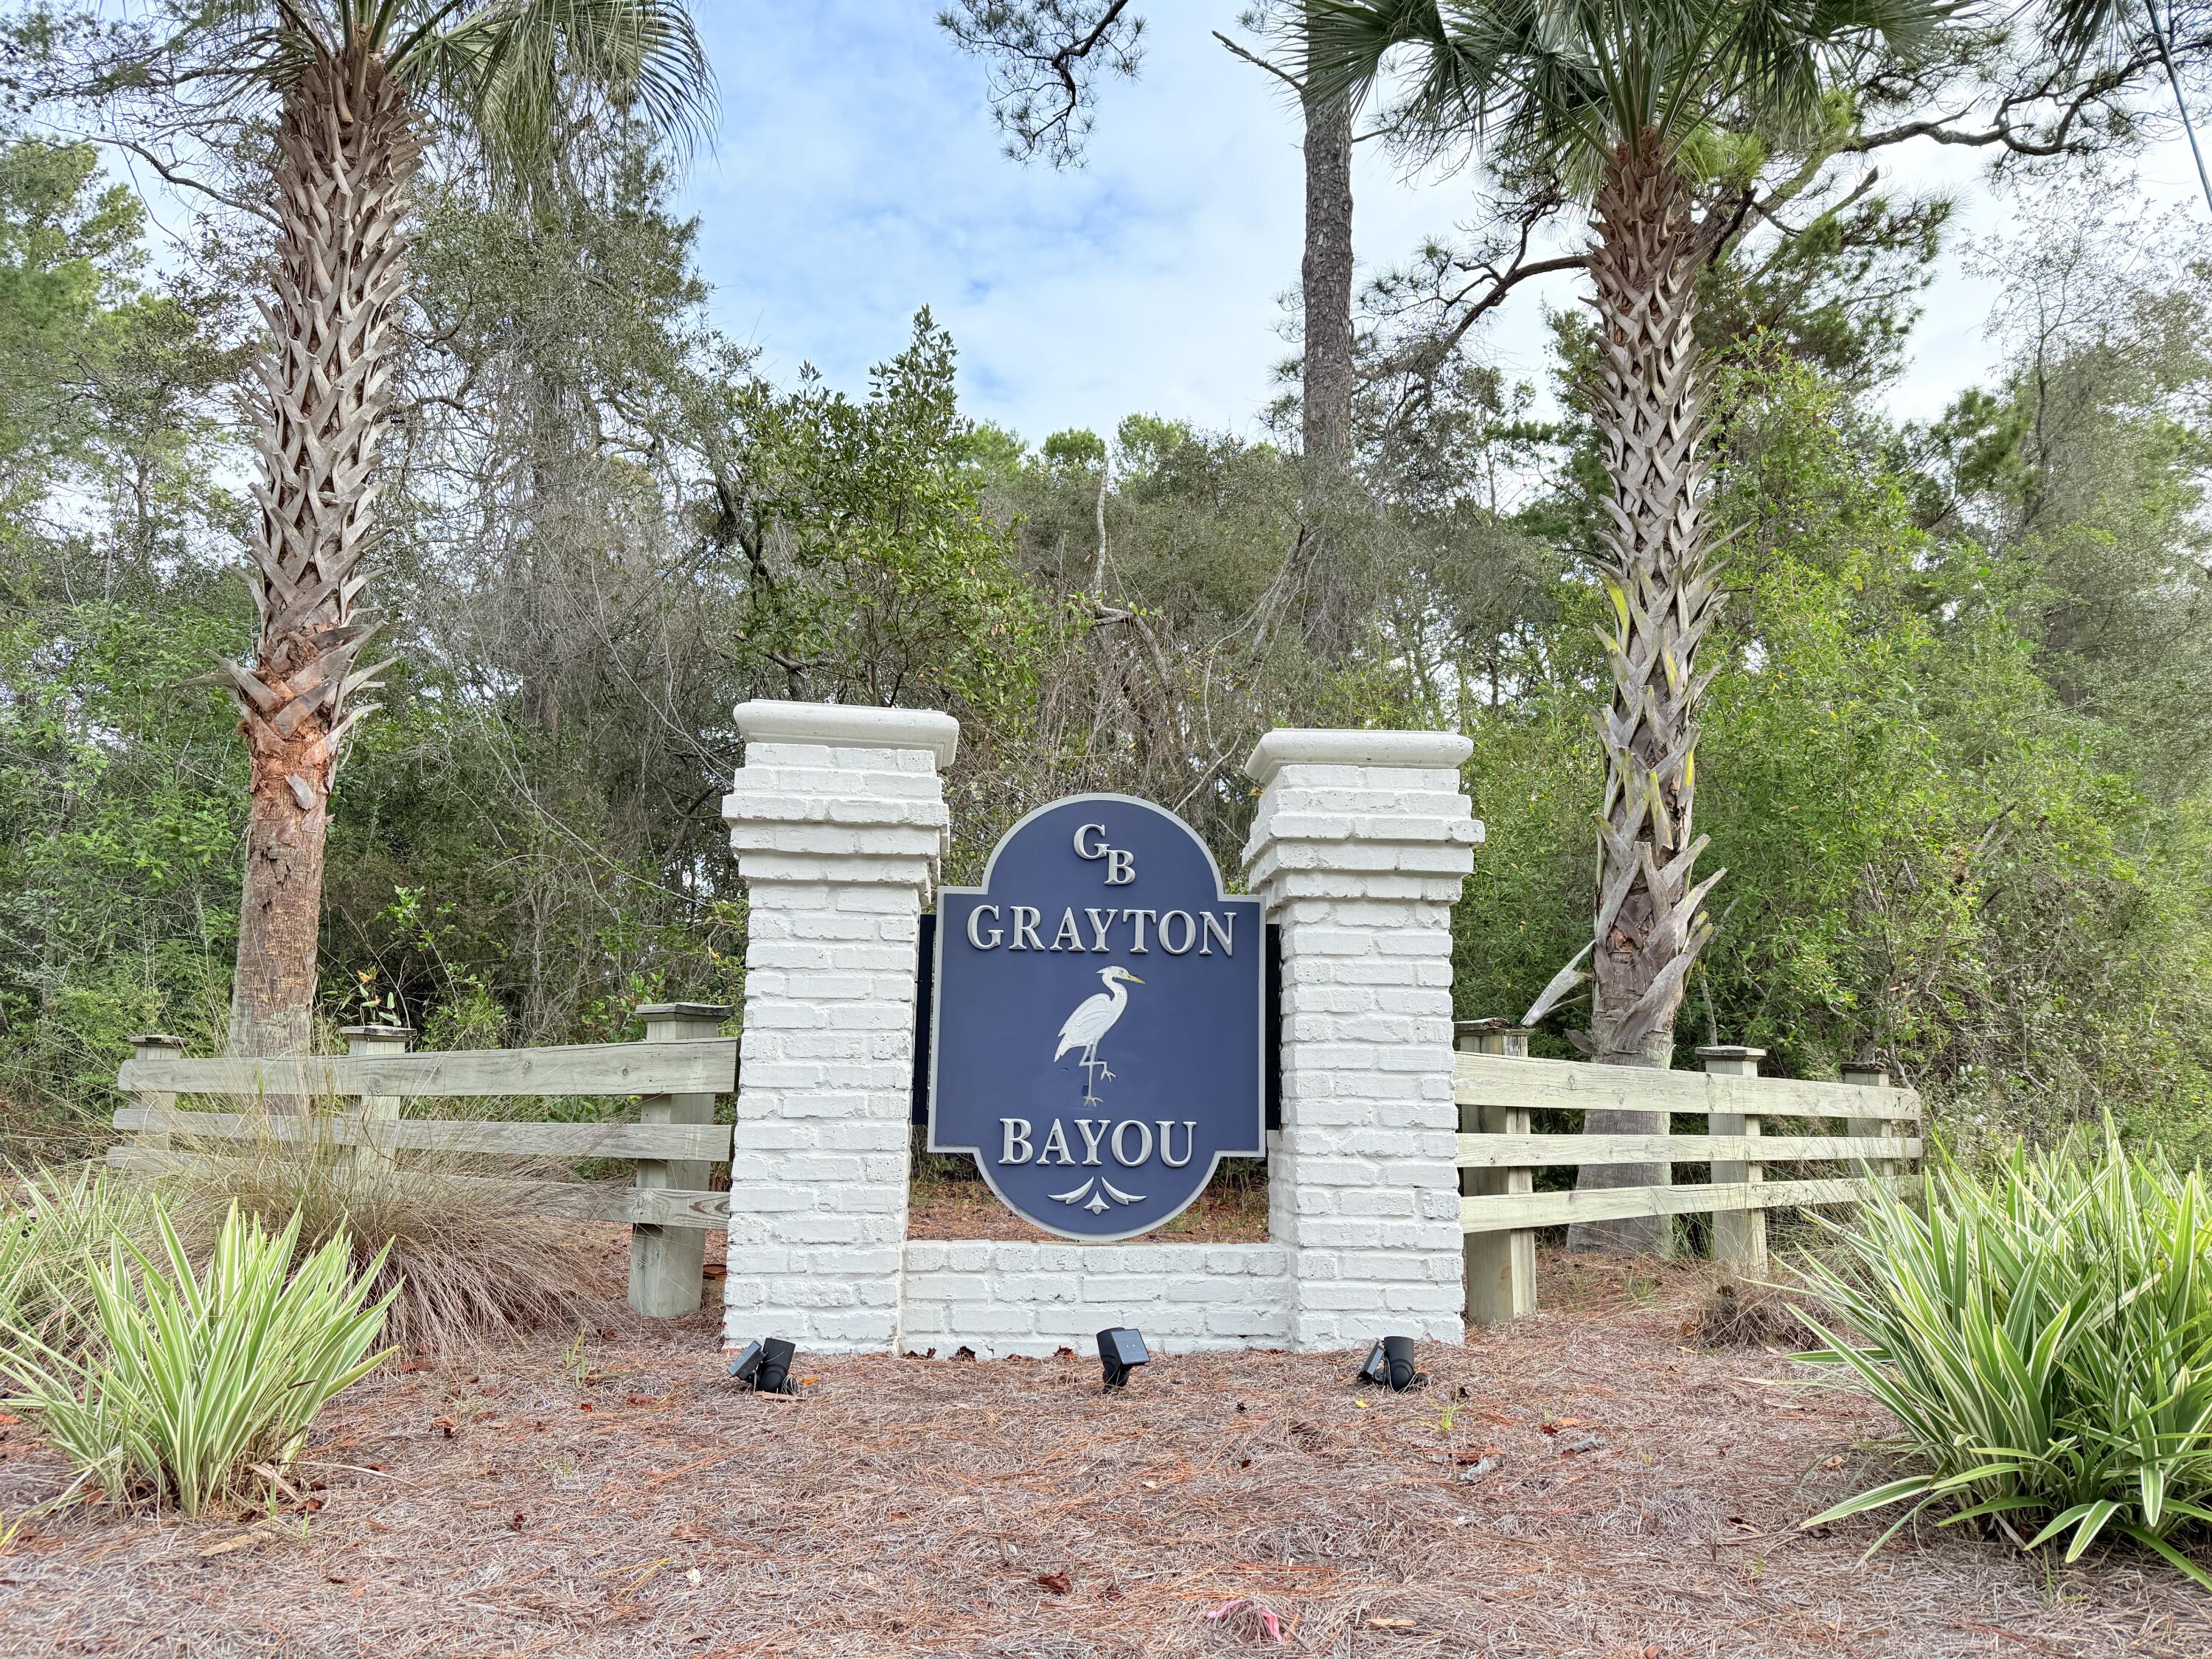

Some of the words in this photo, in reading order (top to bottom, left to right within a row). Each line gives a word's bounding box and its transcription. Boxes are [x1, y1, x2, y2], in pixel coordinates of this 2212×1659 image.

[1074, 824, 1135, 885] GB
[967, 905, 1237, 956] GRAYTON
[998, 1118, 1197, 1167] BAYOU
